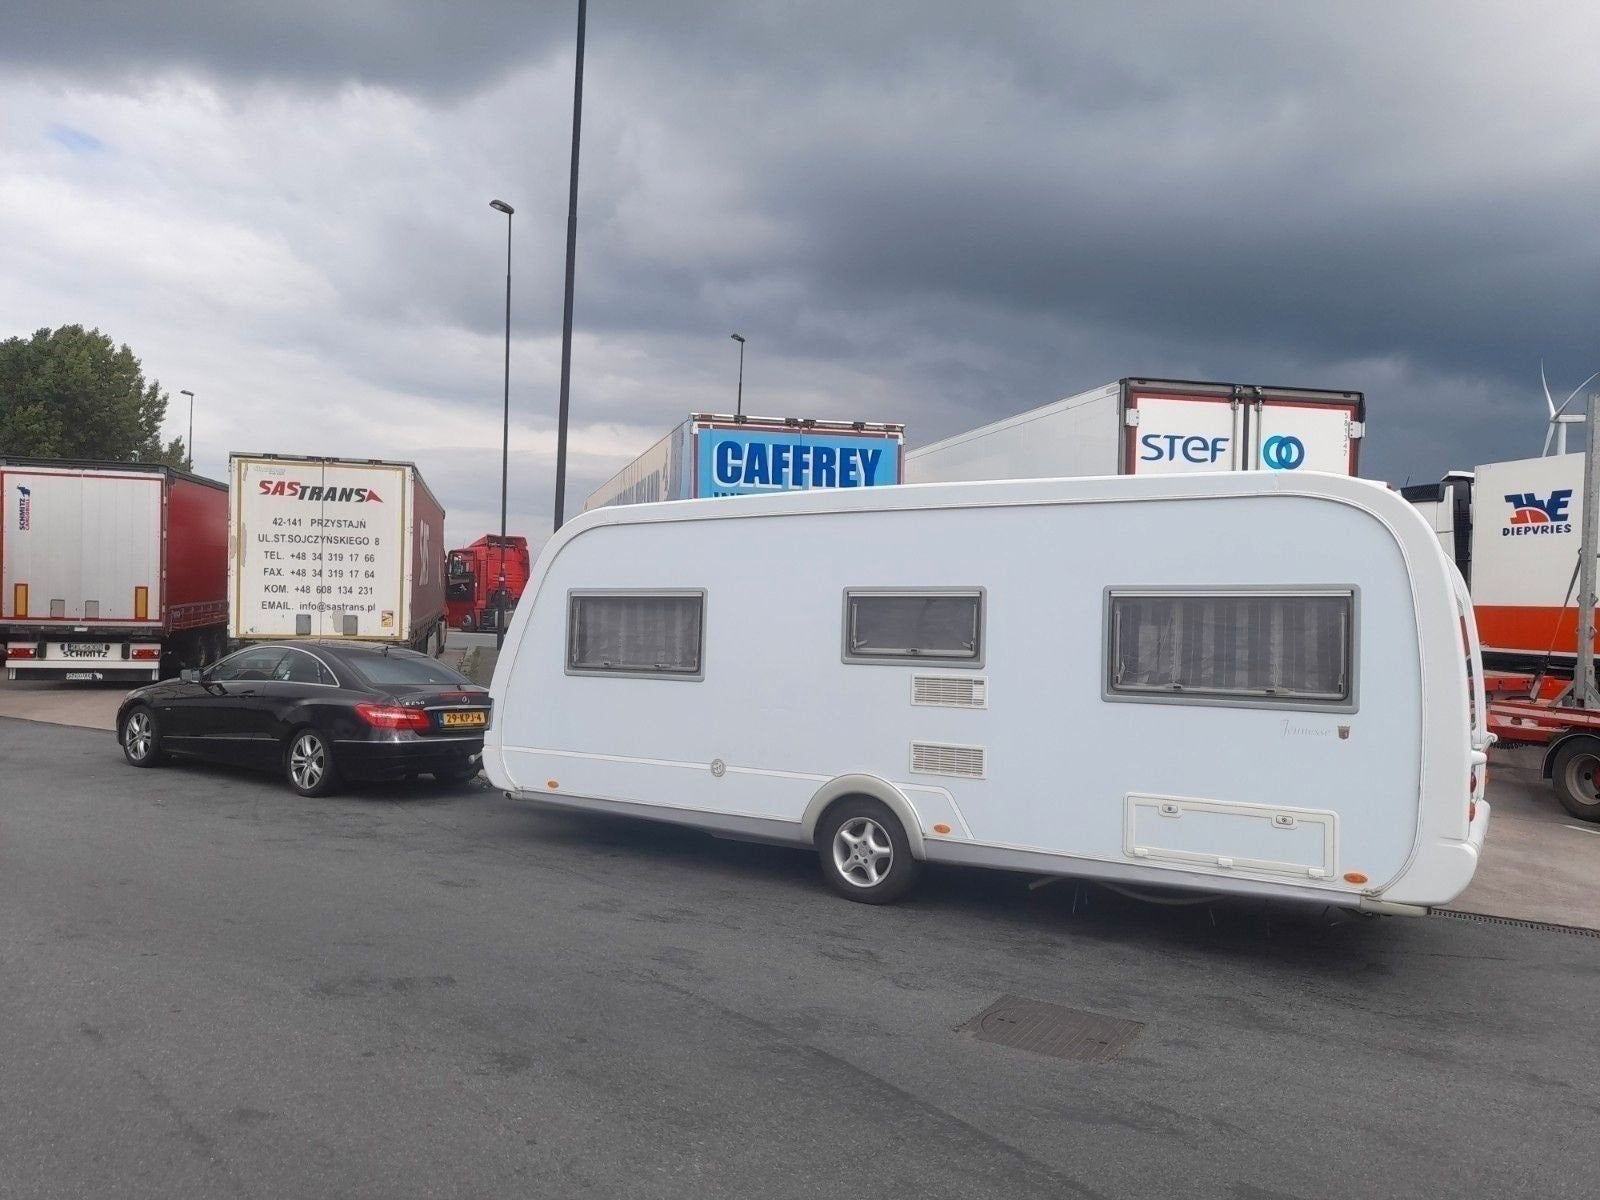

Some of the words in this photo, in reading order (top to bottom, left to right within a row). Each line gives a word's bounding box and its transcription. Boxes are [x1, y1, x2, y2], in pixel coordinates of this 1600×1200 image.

[713, 441, 883, 488] CAFFREY
[258, 480, 367, 503] SASTRANS
[272, 517, 302, 527] 42-141
[1502, 523, 1572, 537] DIEPVRIES
[374, 537, 381, 546] 8
[263, 551, 285, 560] TEL.
[290, 552, 307, 561] +48
[311, 553, 322, 561] 34
[328, 553, 344, 562] 319
[349, 553, 359, 562] 17
[364, 554, 375, 563] 66
[263, 567, 285, 577] FAX.
[290, 568, 307, 577] +48
[311, 569, 322, 578] 34
[328, 569, 344, 578] 319
[349, 570, 359, 578] 17
[364, 570, 375, 579] 64
[263, 584, 289, 594] KOM.
[294, 585, 311, 594] +48
[316, 585, 332, 594] 608
[338, 586, 353, 595] 134
[358, 586, 373, 595] 231
[261, 601, 294, 610] EMAIL.
[299, 601, 376, 613] info@sastrans.pl
[63, 650, 108, 658] SCHMITZ
